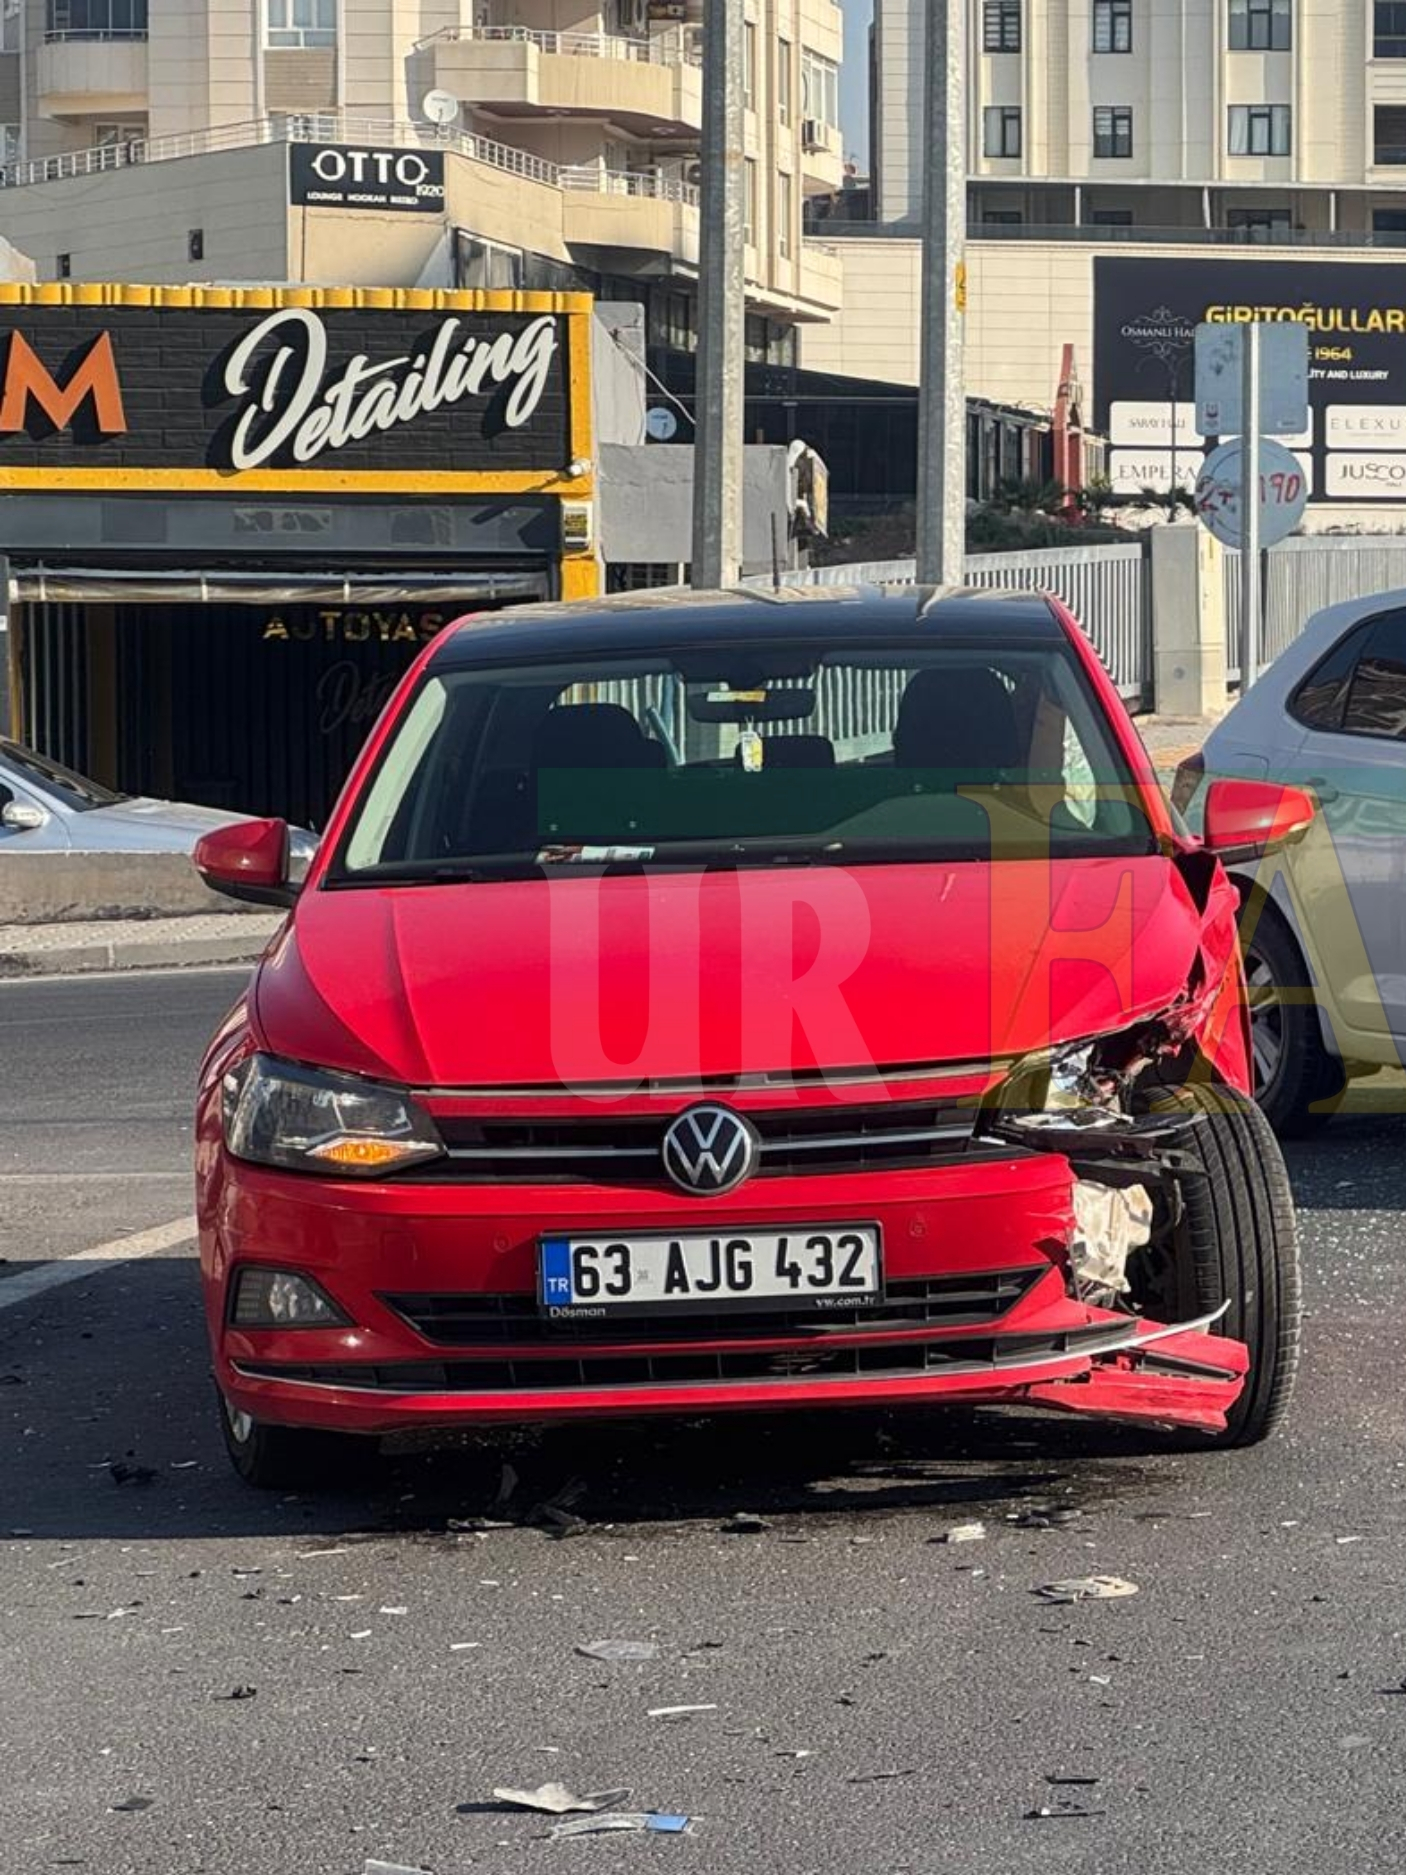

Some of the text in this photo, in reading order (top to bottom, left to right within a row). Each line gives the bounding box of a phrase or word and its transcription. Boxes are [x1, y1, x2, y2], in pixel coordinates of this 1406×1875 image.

[311, 149, 430, 185] OTTO
[306, 191, 343, 201] LOUNGE
[1315, 347, 1352, 361] 1964
[0, 329, 127, 433] M
[1327, 370, 1348, 380] AND
[1350, 370, 1389, 381] LUXURY
[225, 308, 558, 469] Detailing
[1338, 461, 1406, 481] JUSCO
[572, 1234, 866, 1298] 63 AJG 432
[547, 1278, 570, 1294] TR
